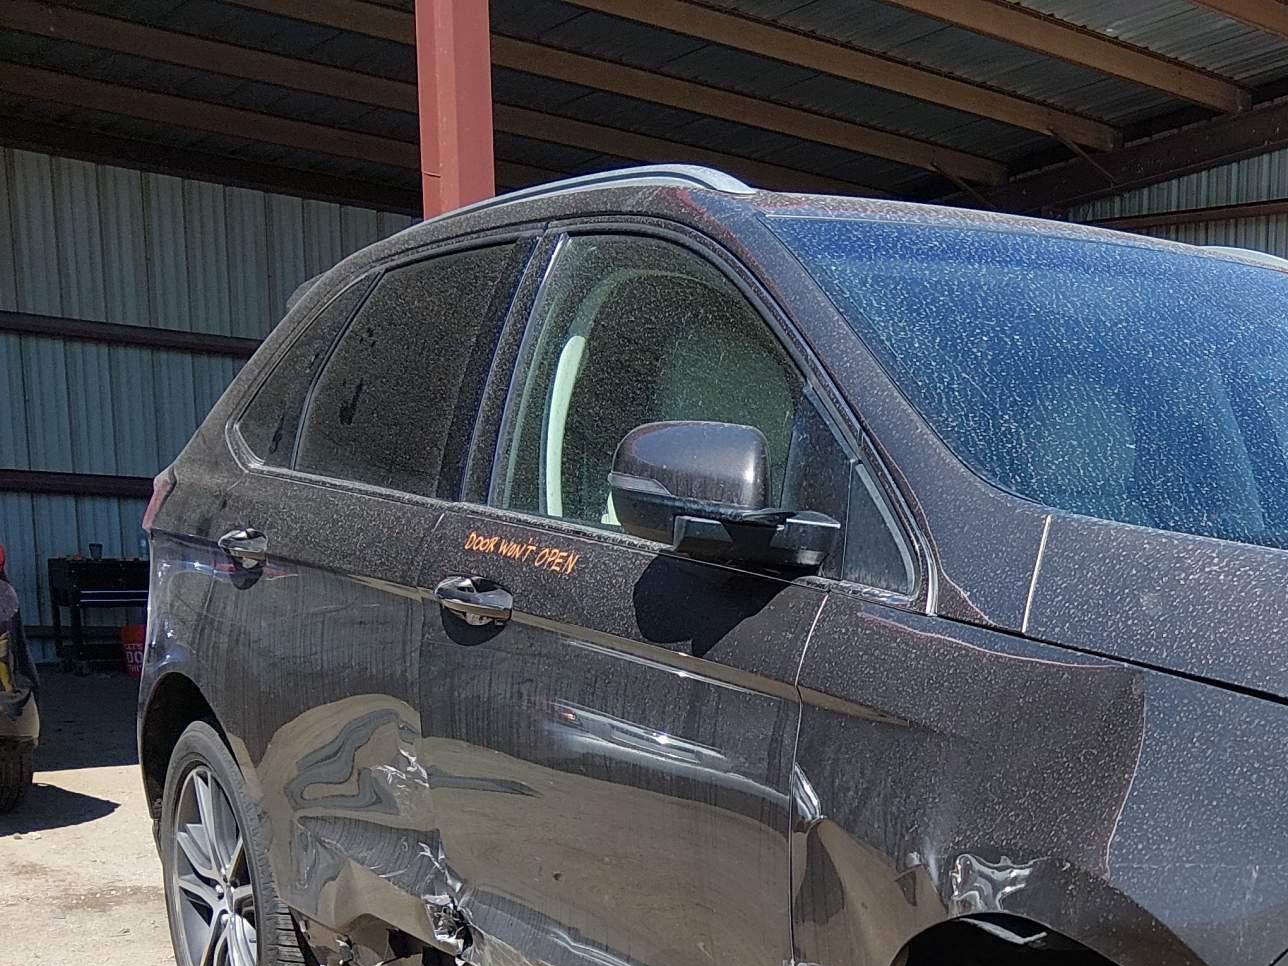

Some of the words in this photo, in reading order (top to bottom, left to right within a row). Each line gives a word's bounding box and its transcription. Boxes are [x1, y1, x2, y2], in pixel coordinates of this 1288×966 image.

[464, 530, 499, 554] DOOR
[498, 537, 536, 562] WON'T
[534, 548, 580, 575] OPEN
